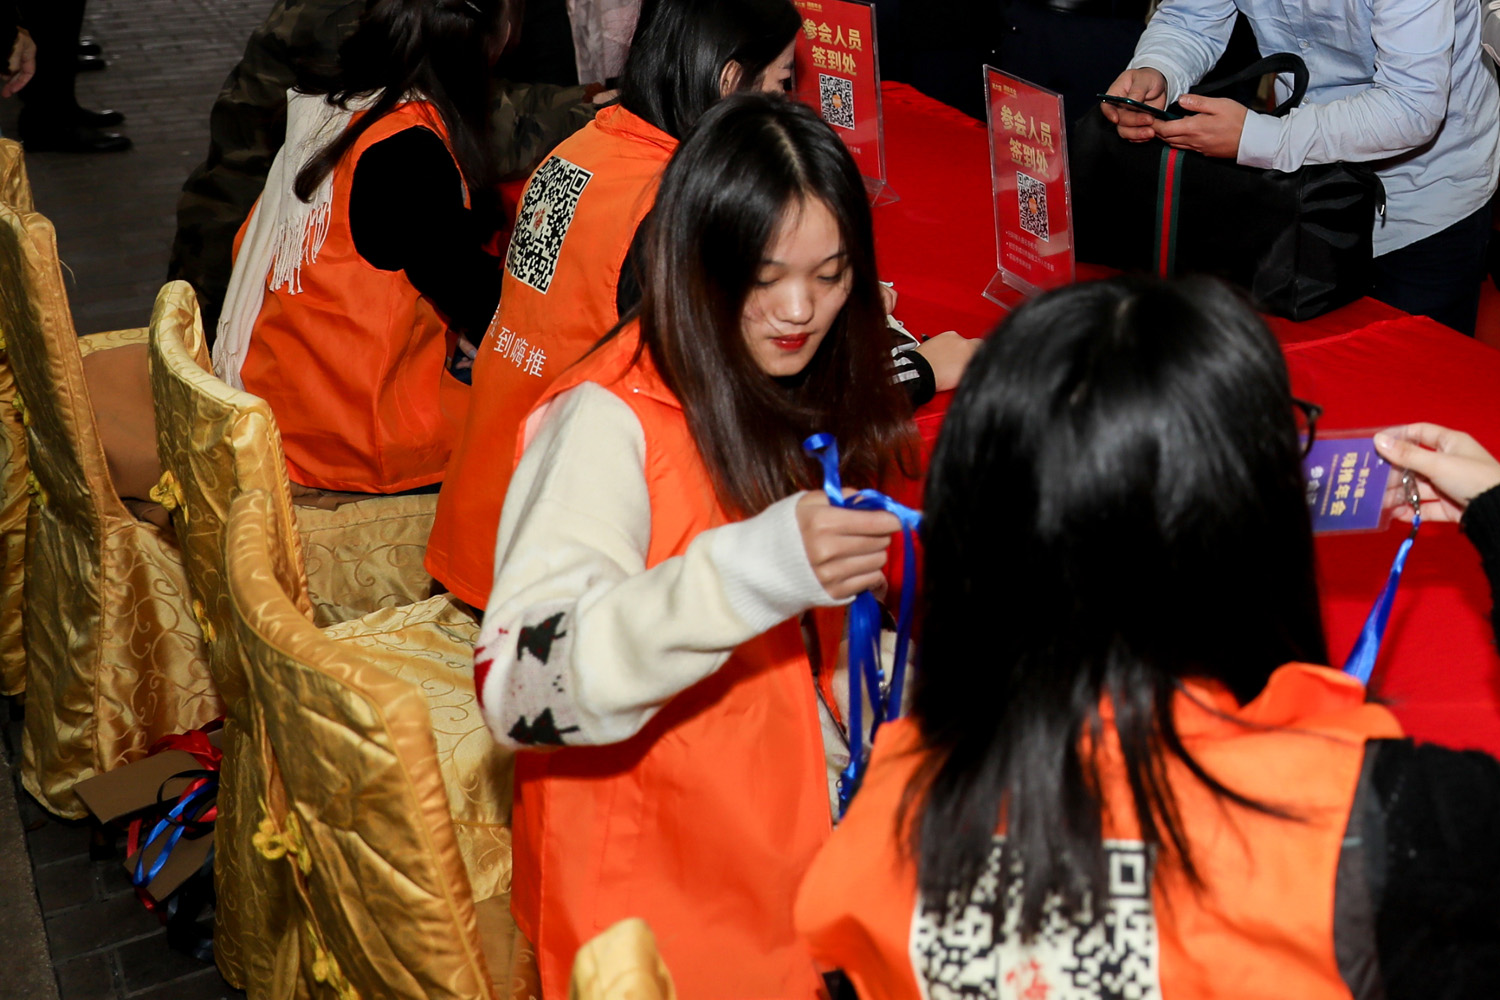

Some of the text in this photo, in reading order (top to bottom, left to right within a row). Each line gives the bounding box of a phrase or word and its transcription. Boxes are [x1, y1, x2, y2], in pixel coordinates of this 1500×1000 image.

[802, 18, 862, 52] 参会人员
[811, 45, 858, 76] 签到处
[1000, 104, 1054, 154] 参会人员
[1009, 137, 1050, 179] 签到处
[493, 326, 547, 378] 到嗨推
